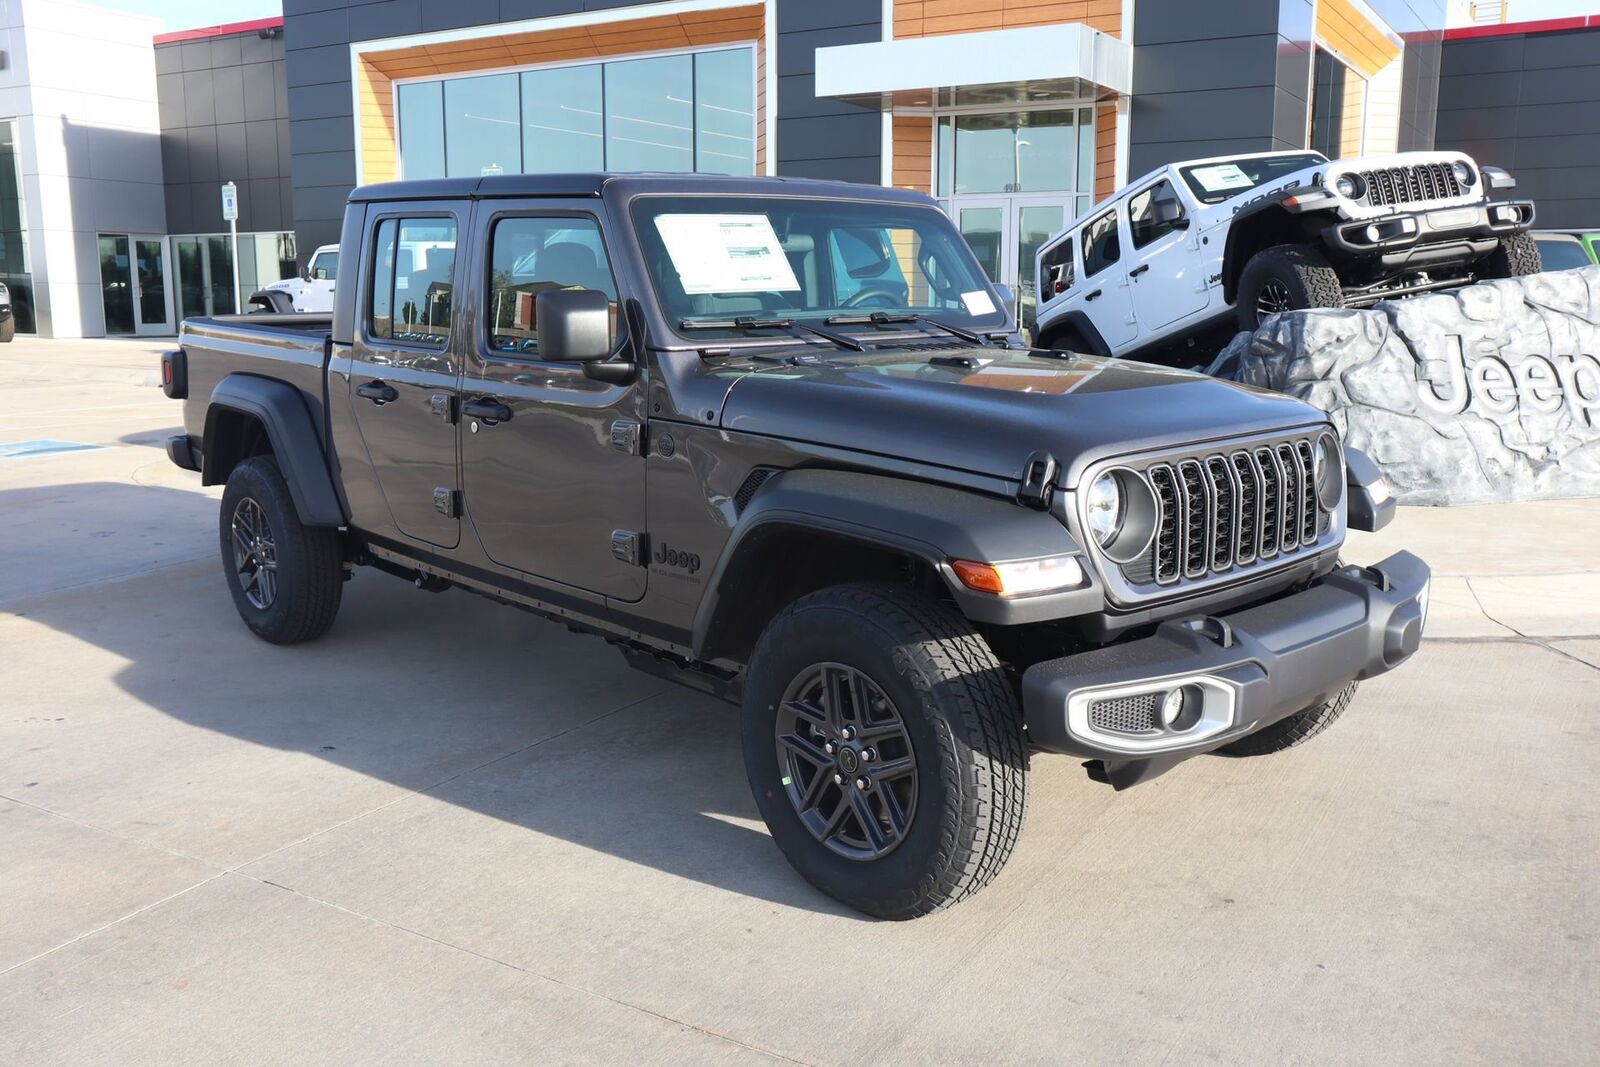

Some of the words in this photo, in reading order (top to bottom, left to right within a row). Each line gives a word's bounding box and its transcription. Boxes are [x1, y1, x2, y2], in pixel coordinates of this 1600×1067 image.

[1208, 271, 1222, 284] Jee
[1416, 334, 1600, 428] Jeep
[654, 542, 701, 575] Jeep
